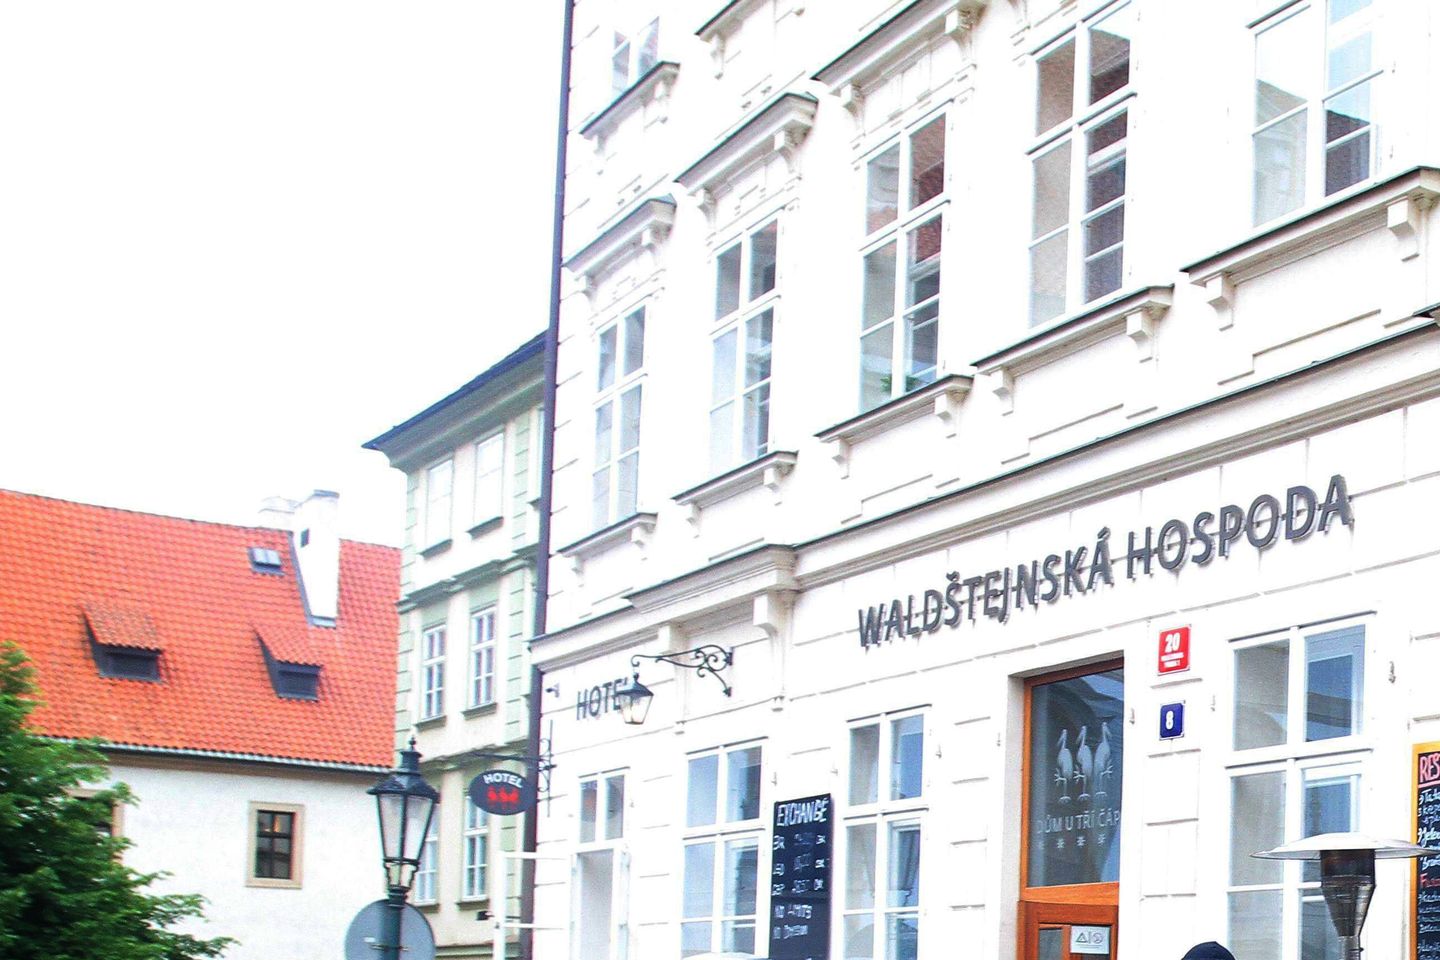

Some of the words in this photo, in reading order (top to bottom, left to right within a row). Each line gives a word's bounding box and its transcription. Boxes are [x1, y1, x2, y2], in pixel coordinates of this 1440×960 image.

[858, 526, 1115, 647] WALDŠTEJNSKÁ
[1126, 474, 1354, 580] HOSPODA
[1164, 632, 1181, 653] 20
[576, 677, 628, 721] HOTE
[1165, 710, 1174, 730] 8
[483, 772, 523, 788] HOTEL
[776, 798, 829, 827] EXCHANGE
[1098, 808, 1121, 828] ČÁP
